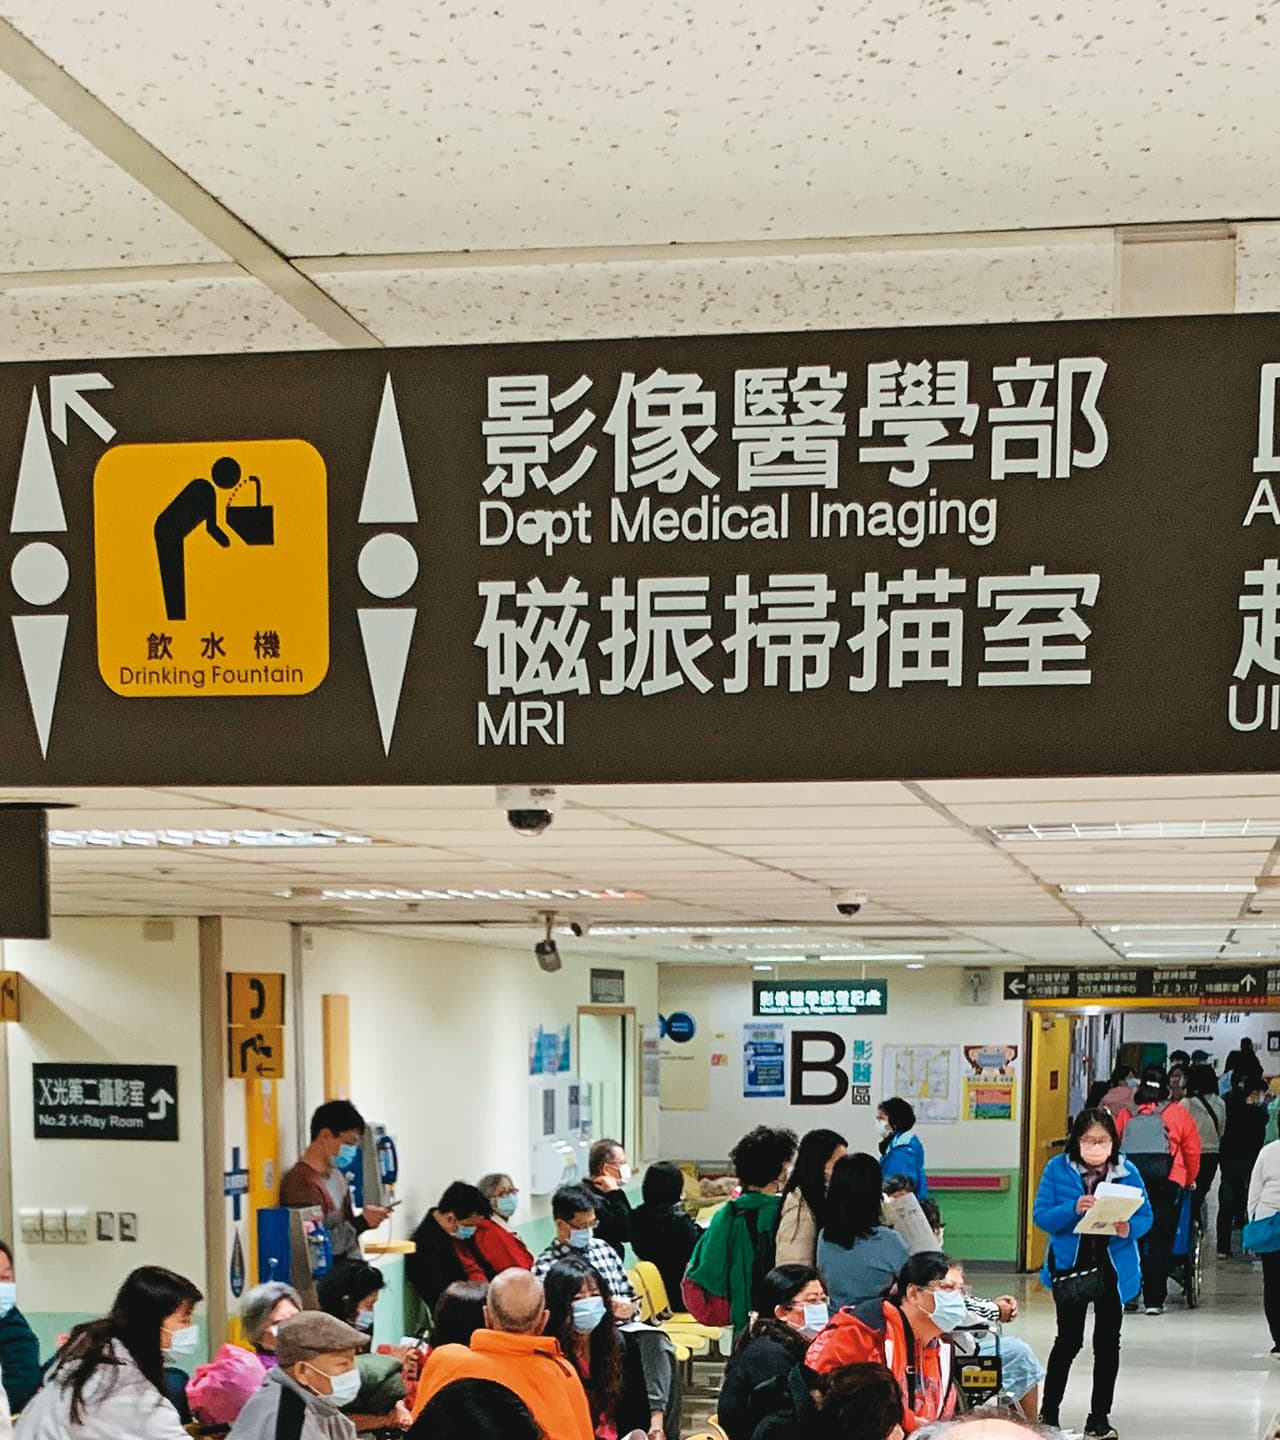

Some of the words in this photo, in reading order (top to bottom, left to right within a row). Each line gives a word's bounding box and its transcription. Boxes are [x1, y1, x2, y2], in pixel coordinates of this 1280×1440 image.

[482, 357, 1111, 498] 影像醫學部
[610, 492, 790, 543] Medical
[811, 489, 998, 548] Imaging
[147, 631, 282, 661] 飲水機
[474, 566, 1102, 697] 磁振掃描室
[121, 666, 206, 689] Drinking
[213, 664, 305, 685] Fountain
[478, 701, 565, 746] MRI
[790, 1031, 849, 1106] B
[70, 1114, 106, 1130] X-Ray
[109, 1115, 144, 1128] Room
